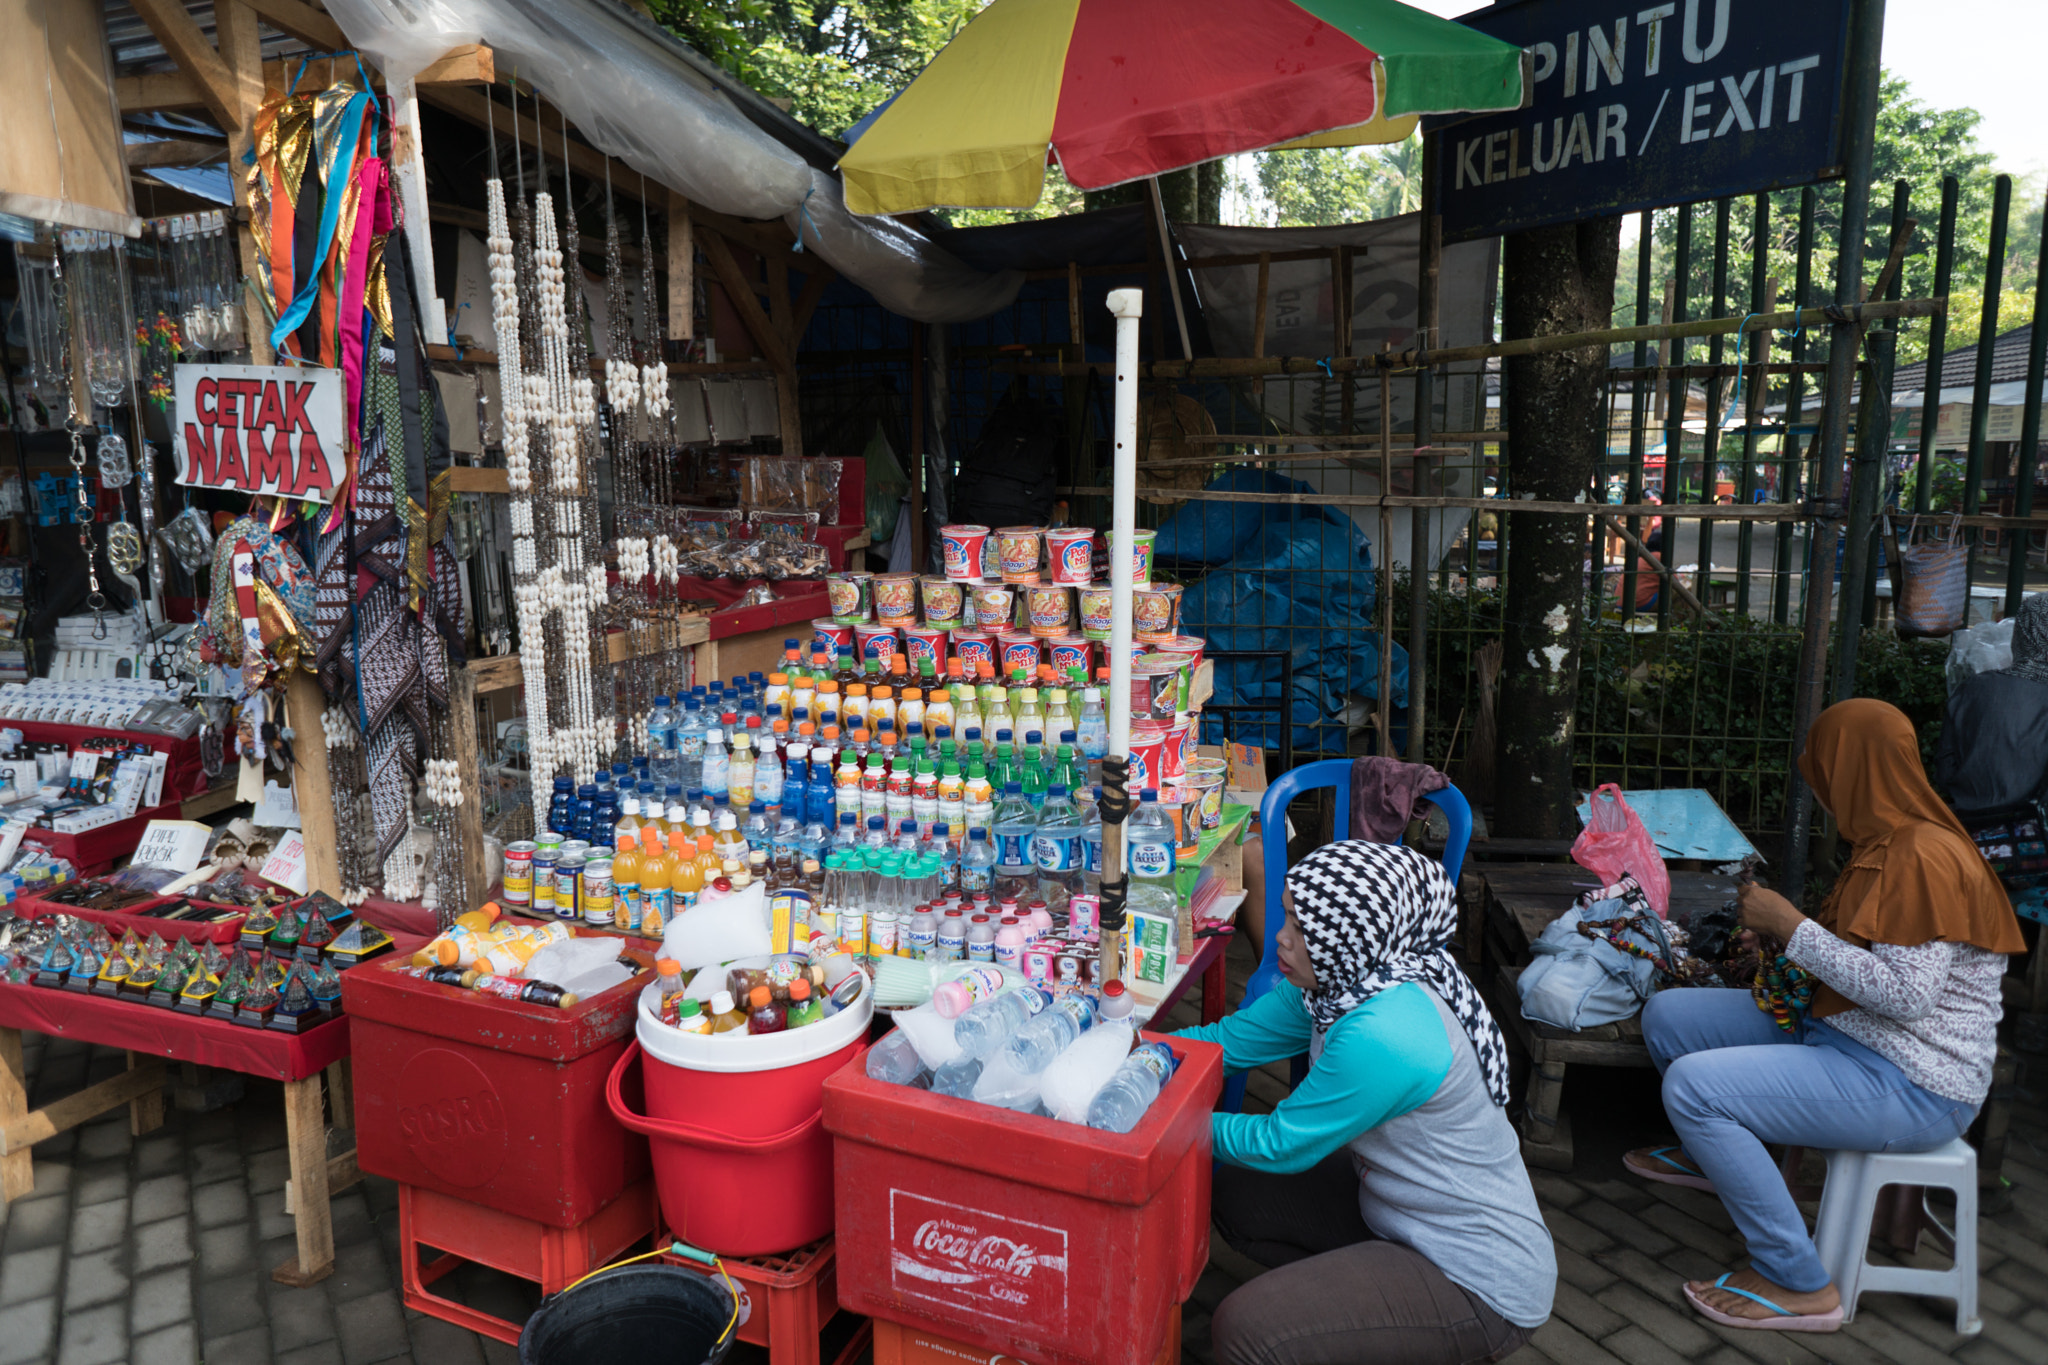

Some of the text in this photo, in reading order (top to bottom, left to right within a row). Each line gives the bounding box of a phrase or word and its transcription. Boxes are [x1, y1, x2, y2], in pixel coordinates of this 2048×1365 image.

[1526, 0, 1731, 108] PINTU
[1455, 103, 1628, 191] KELUAR
[1679, 54, 1821, 145] EXIT
[195, 377, 316, 433] CETAK
[184, 422, 334, 501] NAMA
[1069, 544, 1088, 559] POP
[1001, 561, 1025, 569] edaap
[1074, 553, 1091, 566] MIE
[872, 639, 891, 650] POP
[961, 645, 980, 657] POP
[965, 653, 985, 664] MIE
[1010, 649, 1030, 661] POP
[1056, 651, 1074, 663] POP
[1059, 659, 1079, 671] MIE
[1038, 844, 1057, 860] AQUA
[1134, 851, 1166, 864] AQUA
[938, 936, 964, 946] INDOMIL
[1151, 922, 1164, 951] PASEO
[995, 946, 1015, 955] OMILK
[1148, 952, 1162, 983] PASEO
[989, 1280, 1029, 1305] Coke
[931, 1343, 957, 1357] dahaga
[958, 1352, 987, 1365] pelepas
